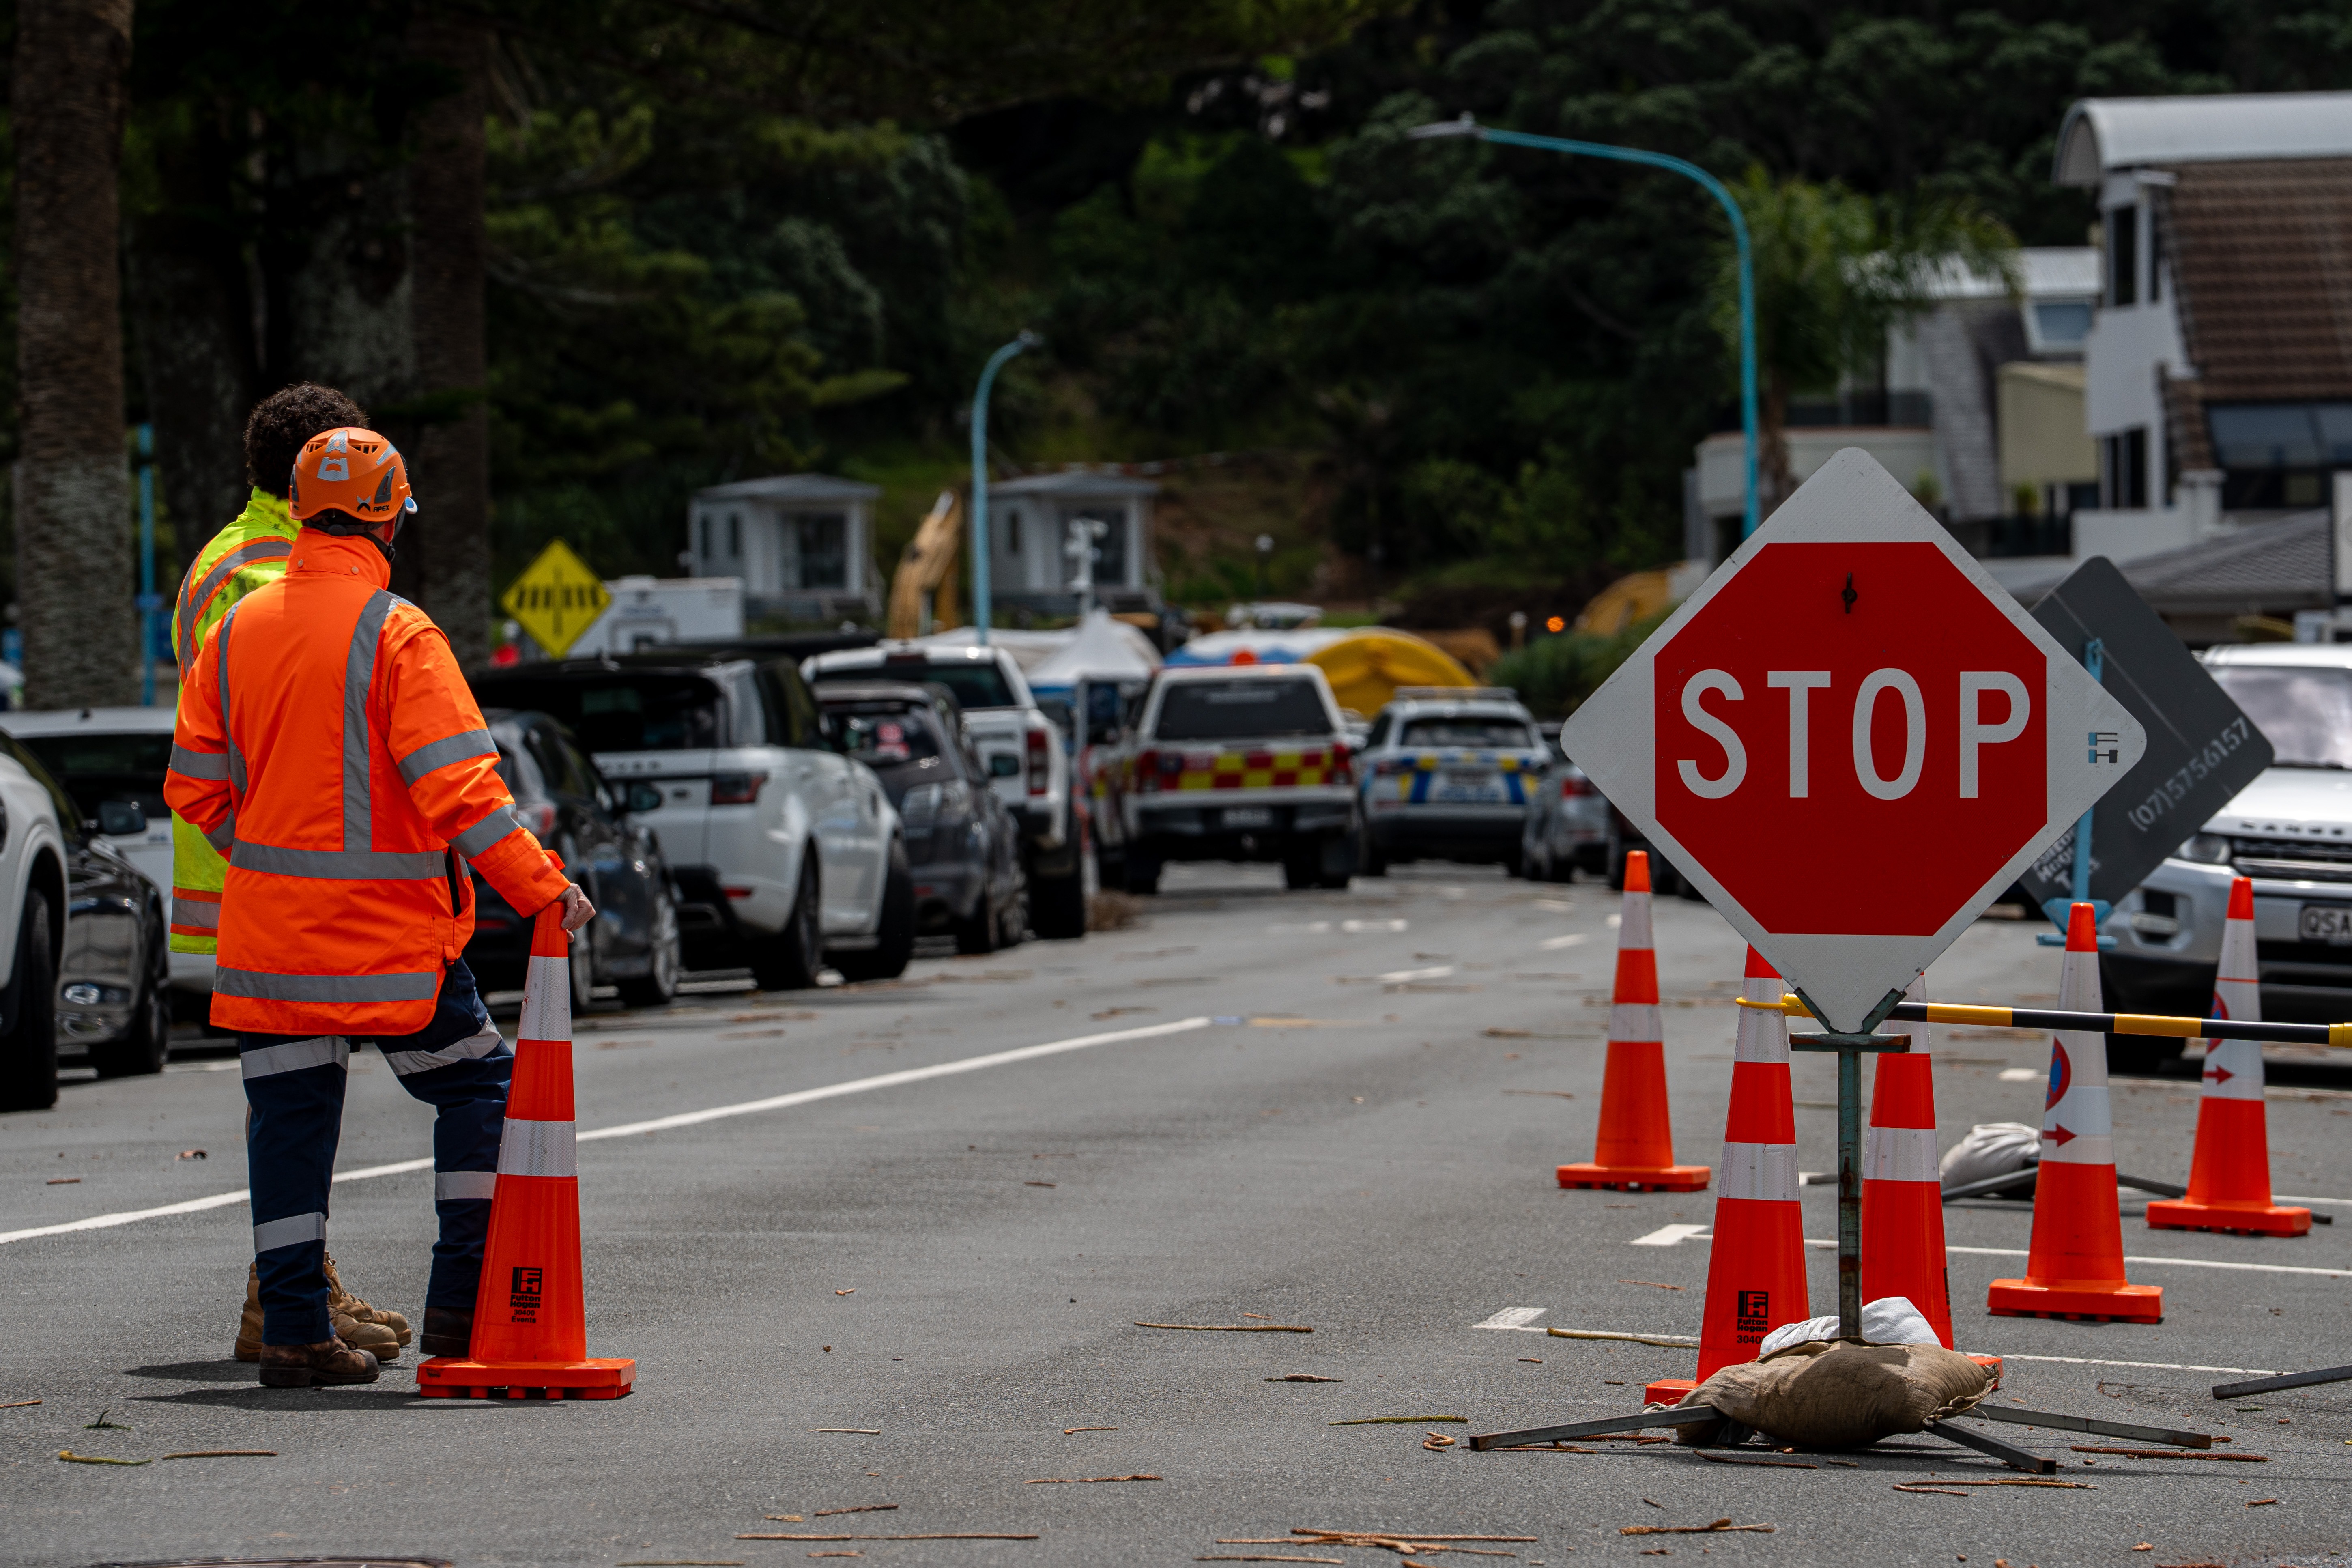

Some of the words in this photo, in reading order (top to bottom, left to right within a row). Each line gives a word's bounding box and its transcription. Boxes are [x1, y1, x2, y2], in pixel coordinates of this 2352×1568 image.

[1677, 668, 2030, 800] STOP
[511, 1294, 541, 1302] Fulton
[510, 1301, 540, 1309] Hogan
[1737, 1335, 1765, 1344] 3040
